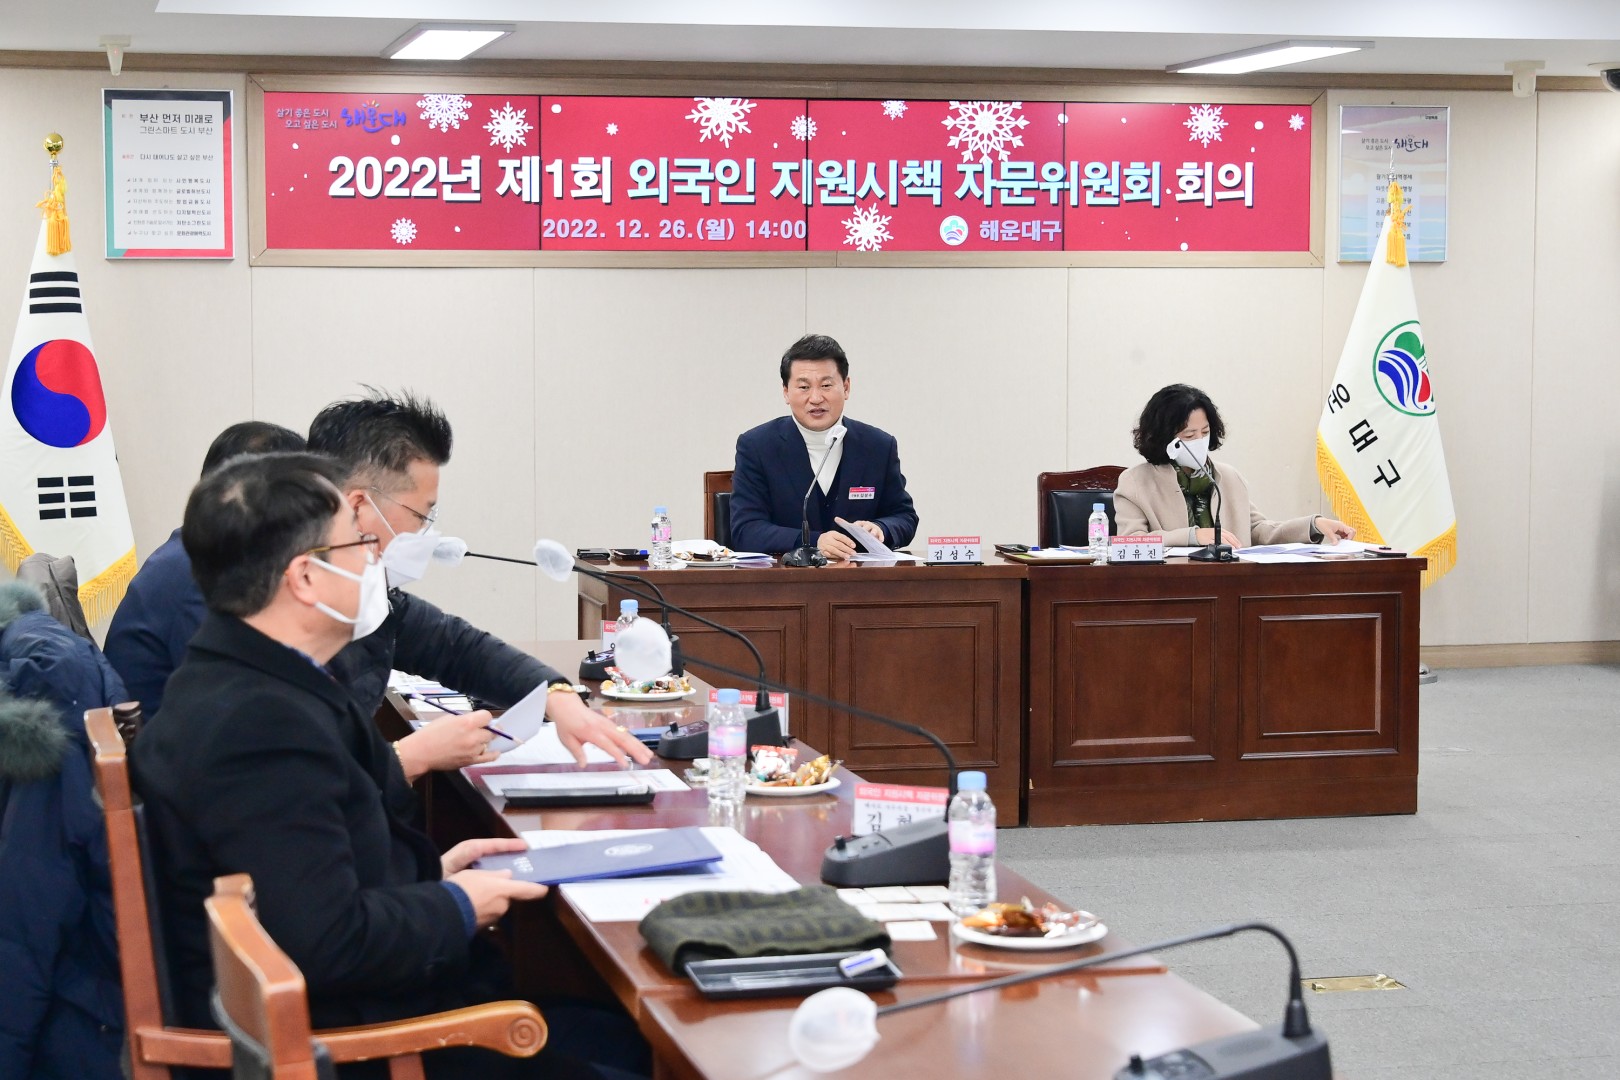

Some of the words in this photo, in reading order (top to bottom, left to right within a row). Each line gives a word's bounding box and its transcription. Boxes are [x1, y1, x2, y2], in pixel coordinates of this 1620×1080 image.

[140, 113, 159, 124] 부산
[162, 113, 181, 124] 먼저
[184, 114, 213, 124] 미래로
[276, 108, 293, 118] 살기
[295, 108, 311, 118] 좋은
[313, 108, 329, 118] 도시
[341, 106, 407, 133] 해운대
[139, 126, 178, 135] 그린스마트
[180, 126, 196, 135] 도시
[198, 127, 213, 136] 부산
[285, 119, 301, 128] 오고
[303, 119, 319, 129] 싶은
[321, 120, 337, 129] 도시
[1393, 138, 1429, 153] 해운대
[328, 155, 482, 202] 2022년
[495, 155, 612, 204] 제1회
[627, 156, 756, 206] 외국인
[769, 158, 943, 206] 지원시책
[954, 159, 1161, 208] 자문위원회
[1174, 161, 1254, 208] 회의
[543, 218, 607, 239] 2022.
[615, 219, 651, 239] 12.
[745, 219, 808, 240] 14:00
[979, 219, 1063, 242] 해운대구
